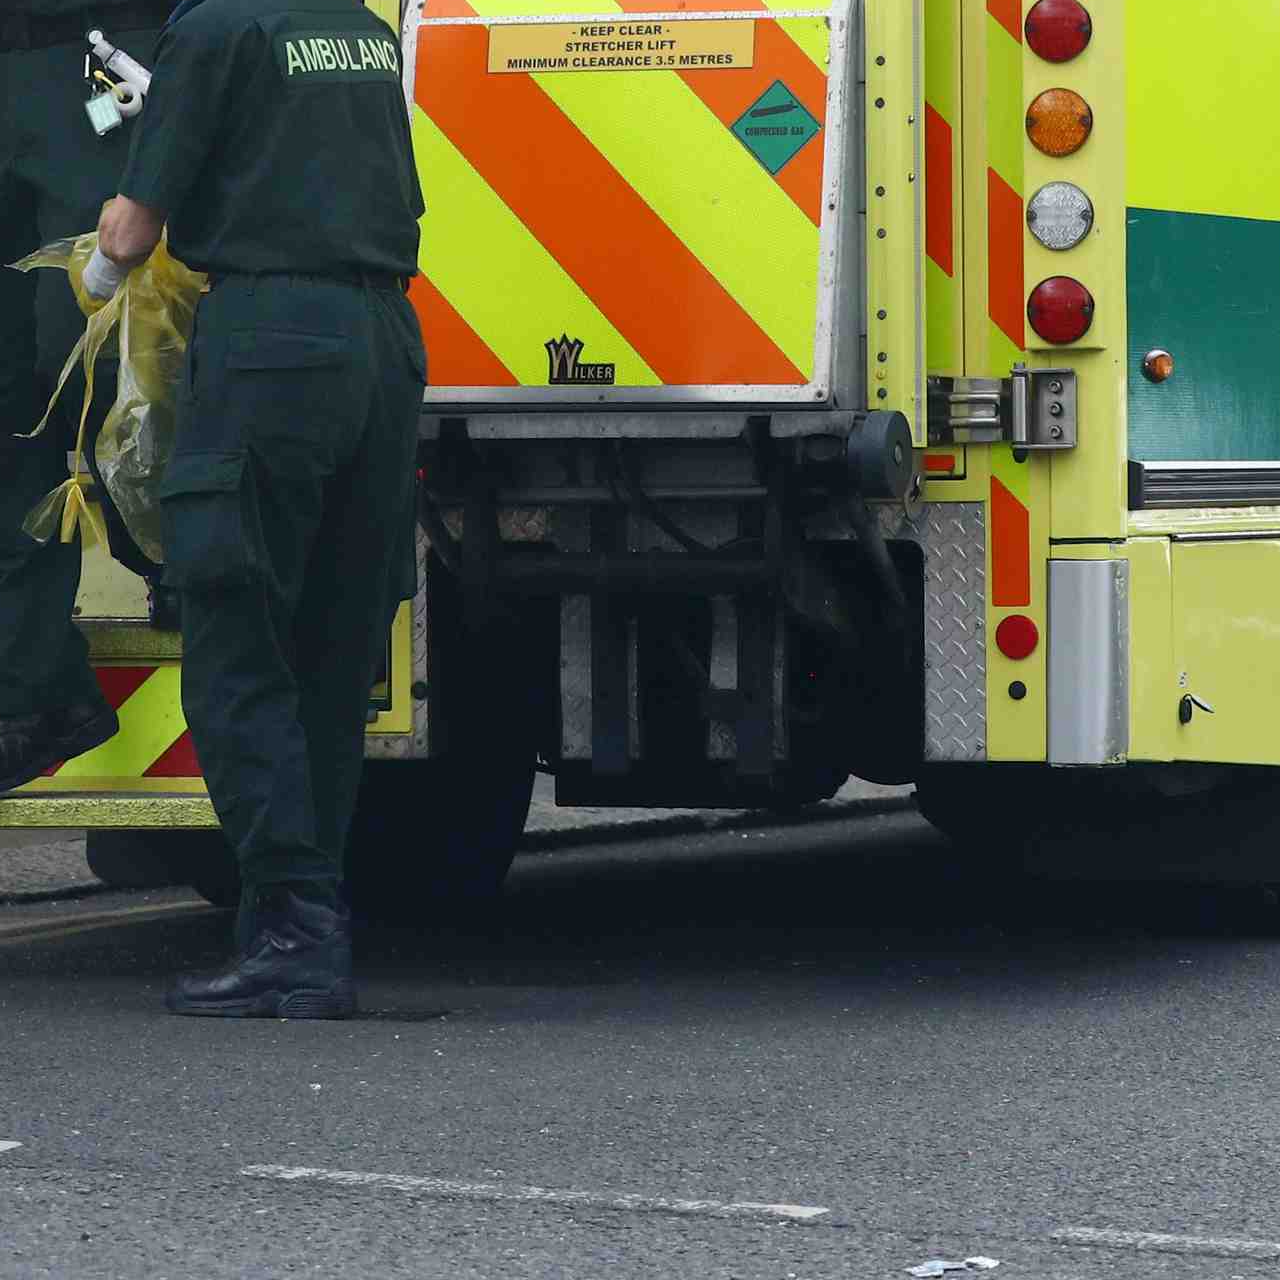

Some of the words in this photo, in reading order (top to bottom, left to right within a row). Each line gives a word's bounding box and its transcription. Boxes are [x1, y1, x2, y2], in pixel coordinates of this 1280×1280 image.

[580, 26, 615, 36] KEEP
[619, 25, 662, 36] CLEAR
[565, 41, 643, 52] STRETCHER
[647, 40, 676, 50] LIFT
[286, 39, 399, 75] AMBULANC
[507, 58, 568, 69] MINIMUM
[572, 56, 651, 67] CLEARANCE
[655, 55, 675, 66] 3.5
[679, 54, 733, 65] METRES
[548, 341, 613, 380] WILKER
